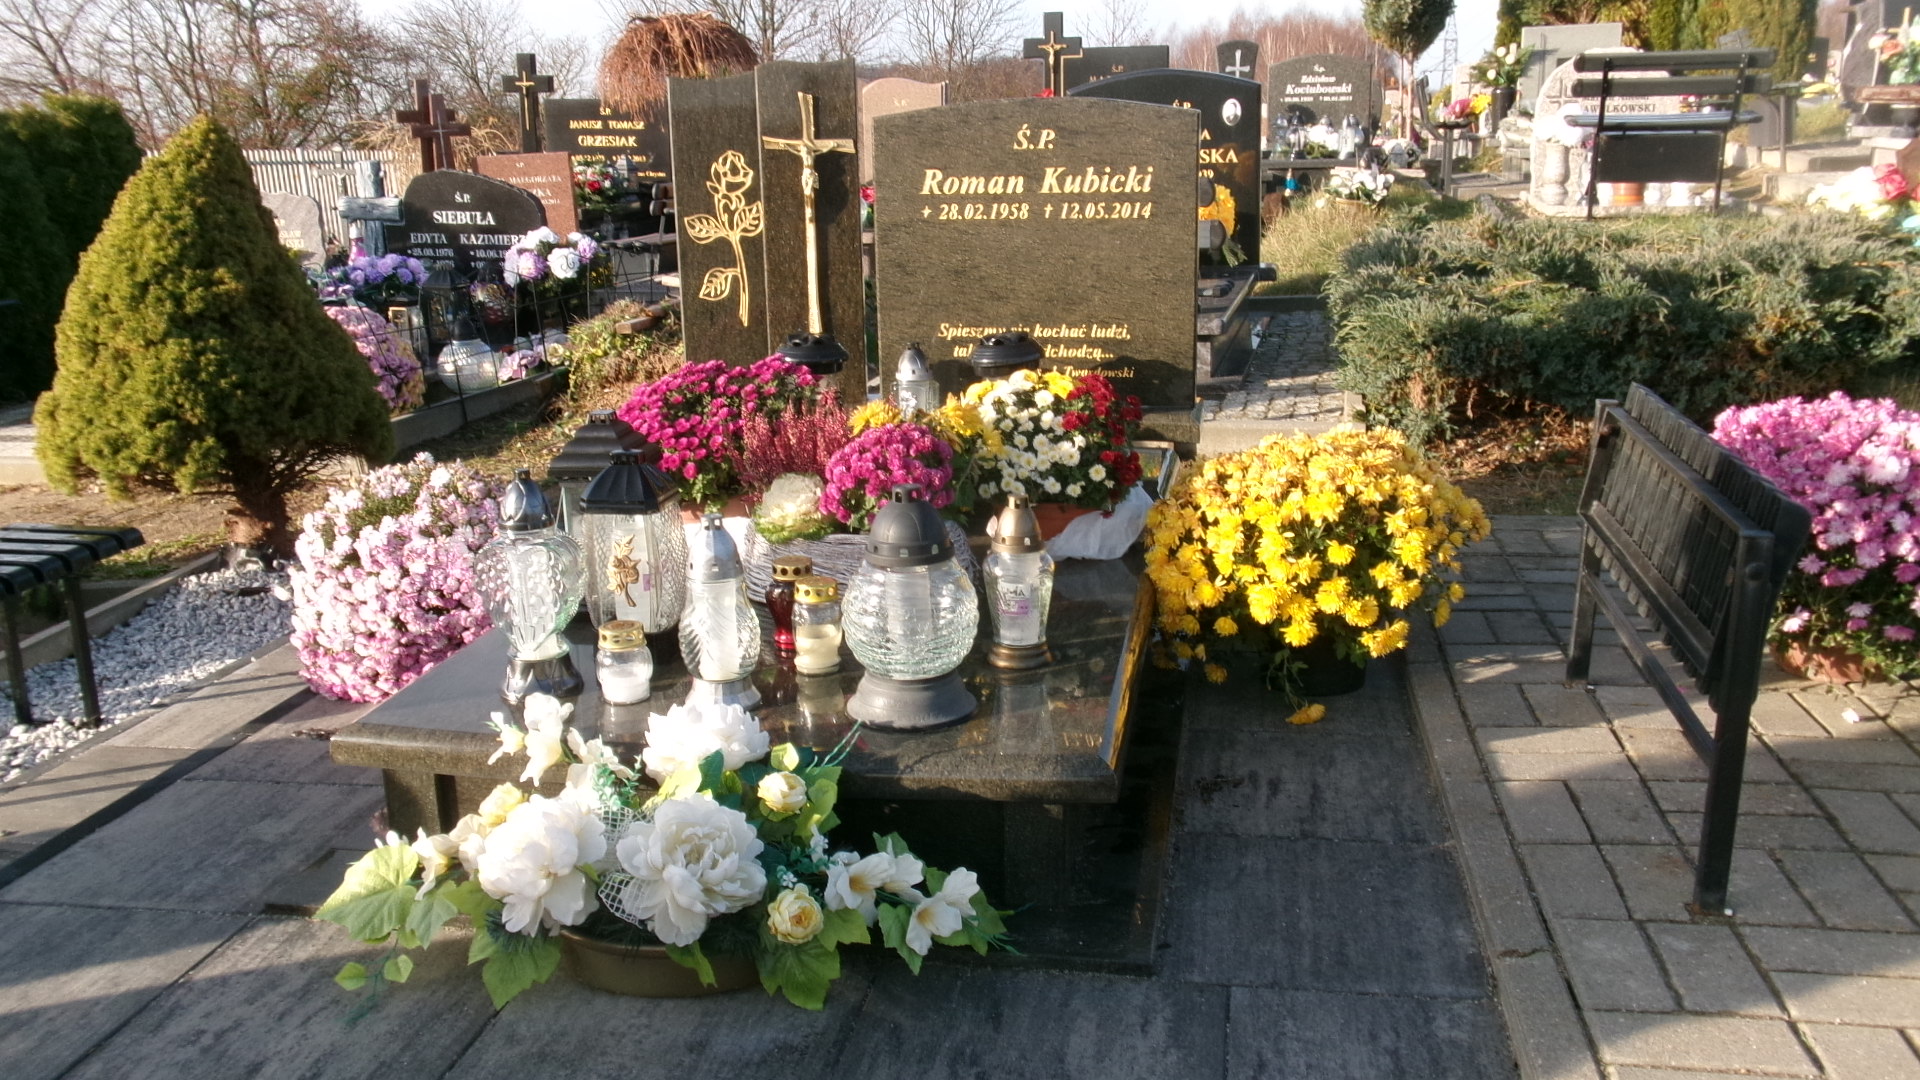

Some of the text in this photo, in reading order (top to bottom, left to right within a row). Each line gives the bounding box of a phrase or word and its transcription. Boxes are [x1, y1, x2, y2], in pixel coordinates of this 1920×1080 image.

[1583, 103, 1656, 114] AWLKOWSKI
[569, 120, 645, 129] JANUSZ TOMASZ
[578, 135, 638, 147] GRZESIAK
[1013, 124, 1056, 150] Ś.P.
[1199, 149, 1239, 163] SKA
[919, 165, 1154, 195] Roman Kubicki
[433, 211, 496, 226] SIEBUŁA
[938, 202, 1152, 220] 28.02.1958 12.05.2014
[410, 233, 448, 244] EDYTA
[1033, 323, 1087, 338] kochać
[1043, 343, 1114, 361] dchodzą...
